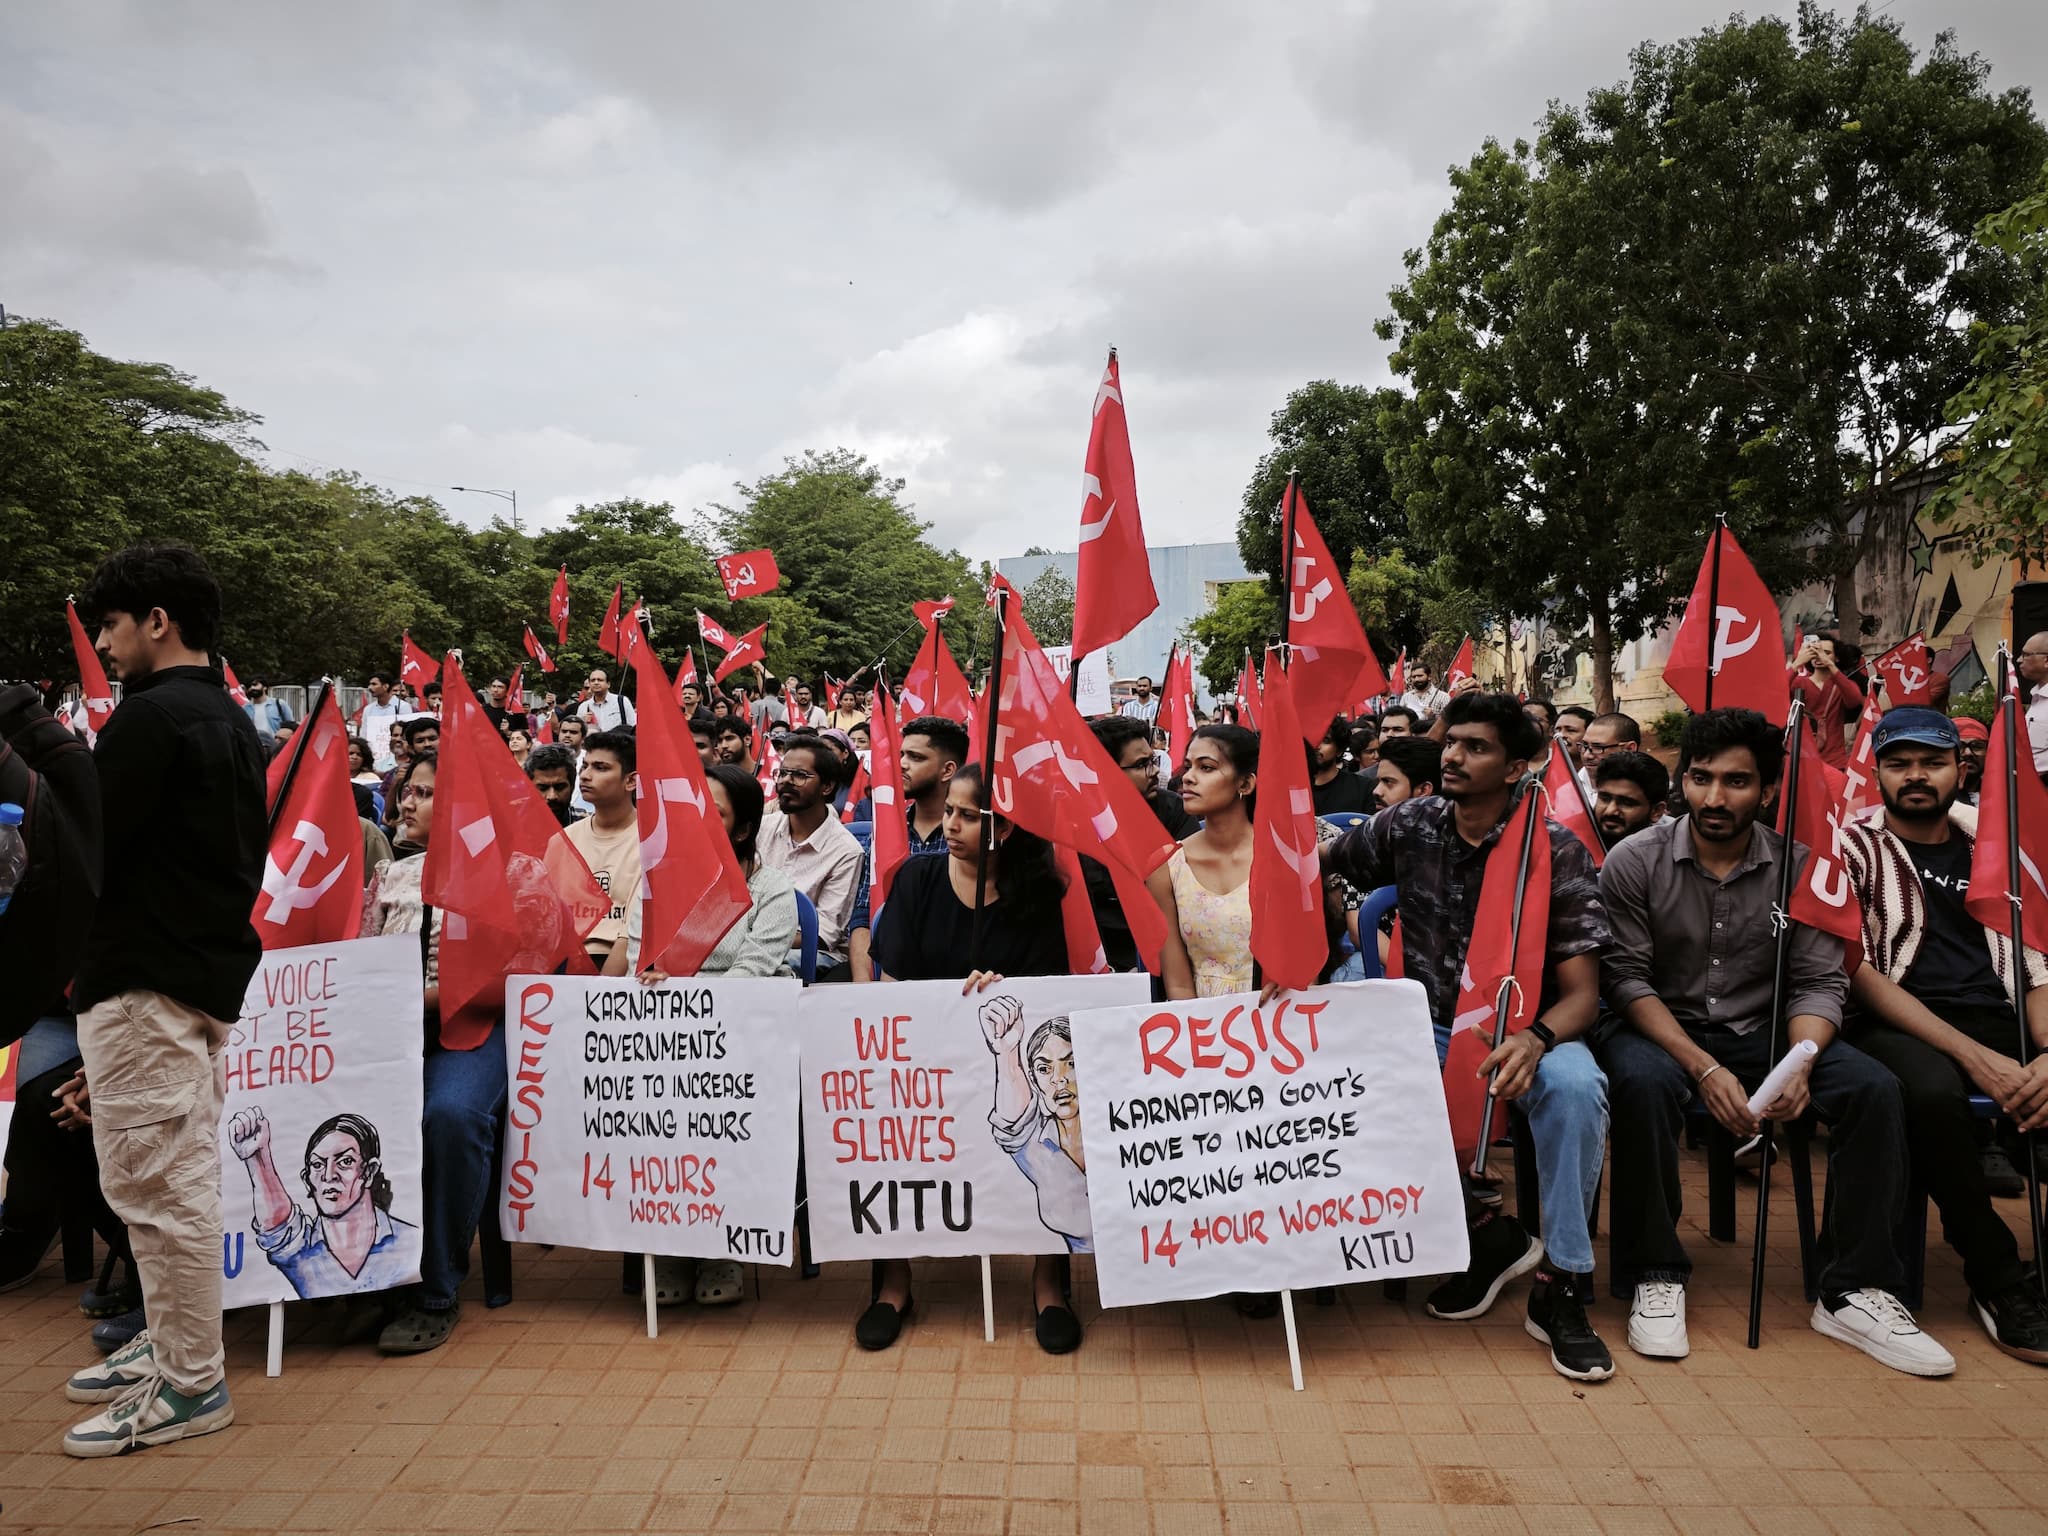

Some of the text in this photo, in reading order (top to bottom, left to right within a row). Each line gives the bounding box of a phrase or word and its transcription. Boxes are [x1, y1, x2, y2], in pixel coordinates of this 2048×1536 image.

[264, 958, 338, 1009] VOICE
[585, 988, 714, 1023] KARNATAKA
[224, 1007, 332, 1047] ST BE
[584, 1021, 727, 1063] GOVERNMENT'S
[854, 1015, 912, 1062] WE
[1138, 999, 1330, 1079] RESIST
[225, 1043, 335, 1094] HEARD
[584, 1071, 756, 1101] MOVE TO INCREASE
[821, 1068, 955, 1112] ARE NOT
[508, 982, 554, 1233] RESIST
[1108, 1067, 1366, 1132] KARNATAKA GOVT'S
[583, 1106, 752, 1143] WORKING HOURS
[832, 1115, 956, 1163] SLAVES
[1120, 1110, 1360, 1169] MOVE TO INCREASE
[582, 1151, 718, 1200] 14 HOURS
[1128, 1148, 1342, 1209] WORKING HOURS
[849, 1179, 973, 1235] KITU
[726, 1224, 785, 1257] KITU
[1140, 1218, 1183, 1268] 14
[1190, 1209, 1270, 1251] HOUR
[1339, 1230, 1415, 1272] KITU
